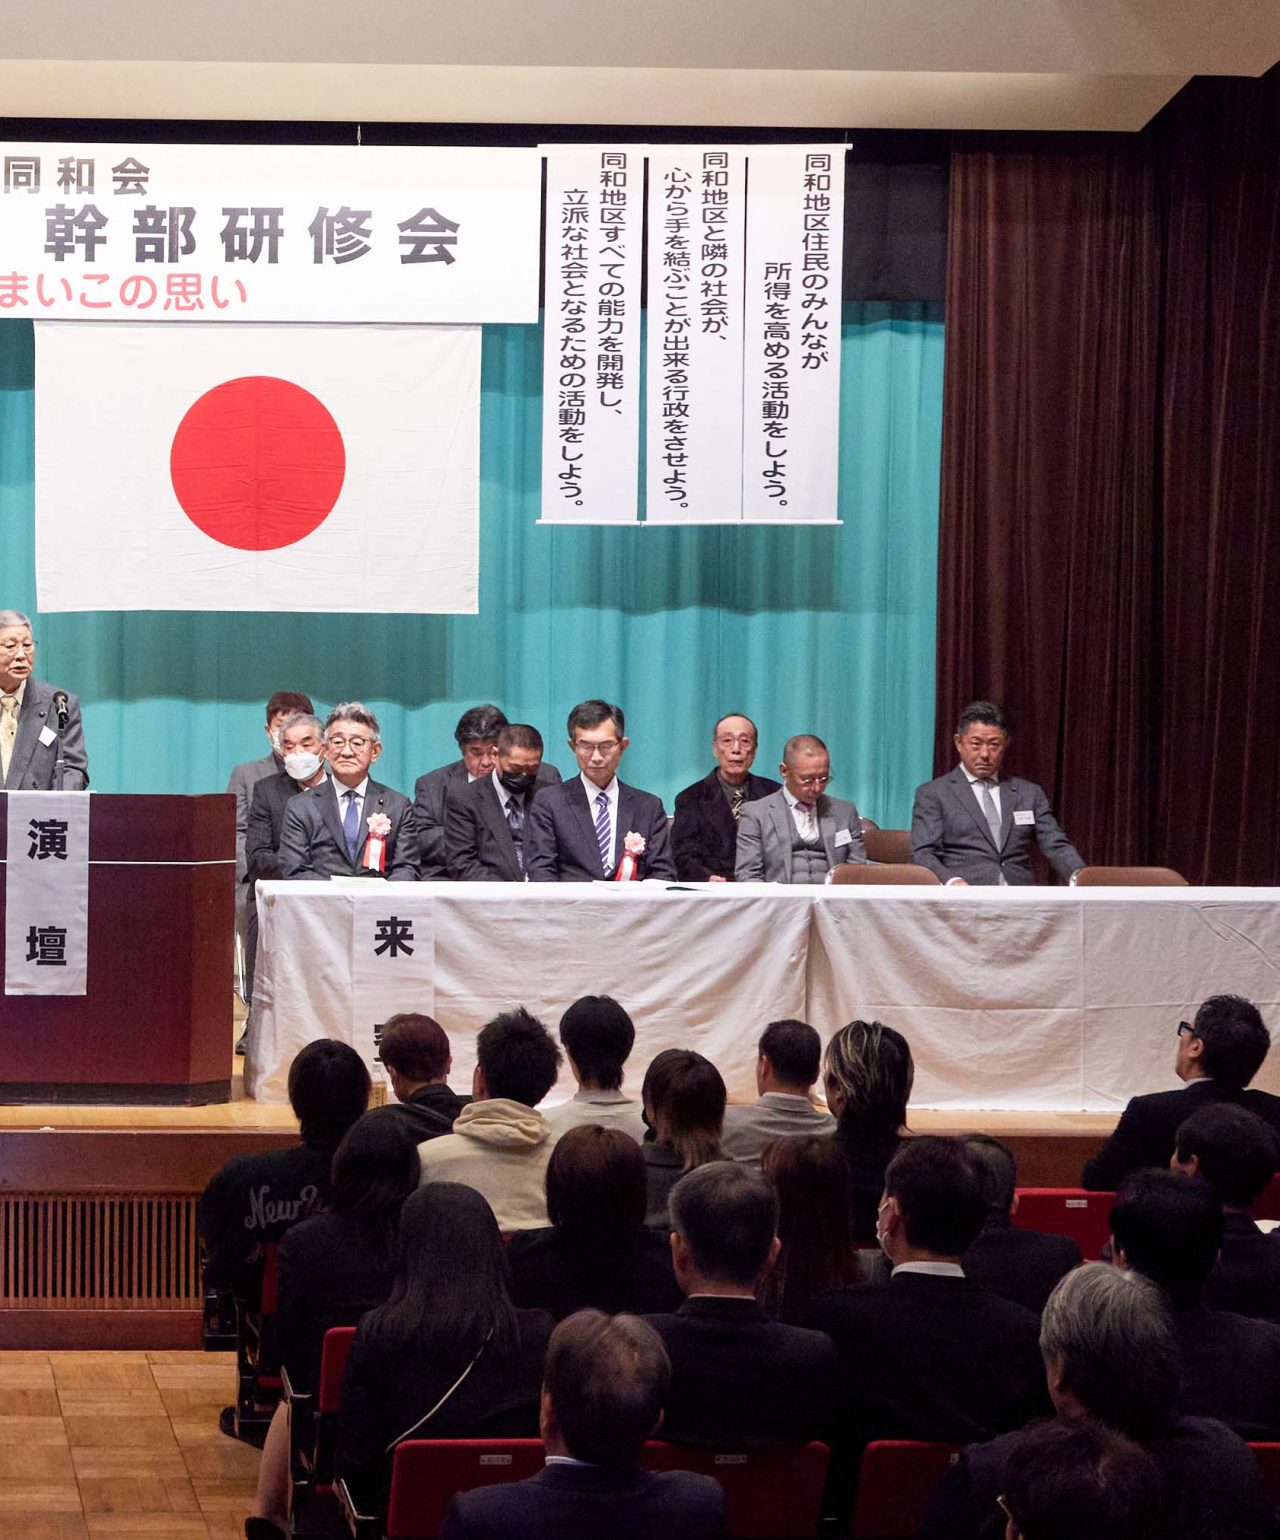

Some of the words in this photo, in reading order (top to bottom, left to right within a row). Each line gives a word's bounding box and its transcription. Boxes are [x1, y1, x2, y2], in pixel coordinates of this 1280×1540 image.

[45, 204, 460, 265] 幹部研修会
[26, 819, 68, 965] 演壇
